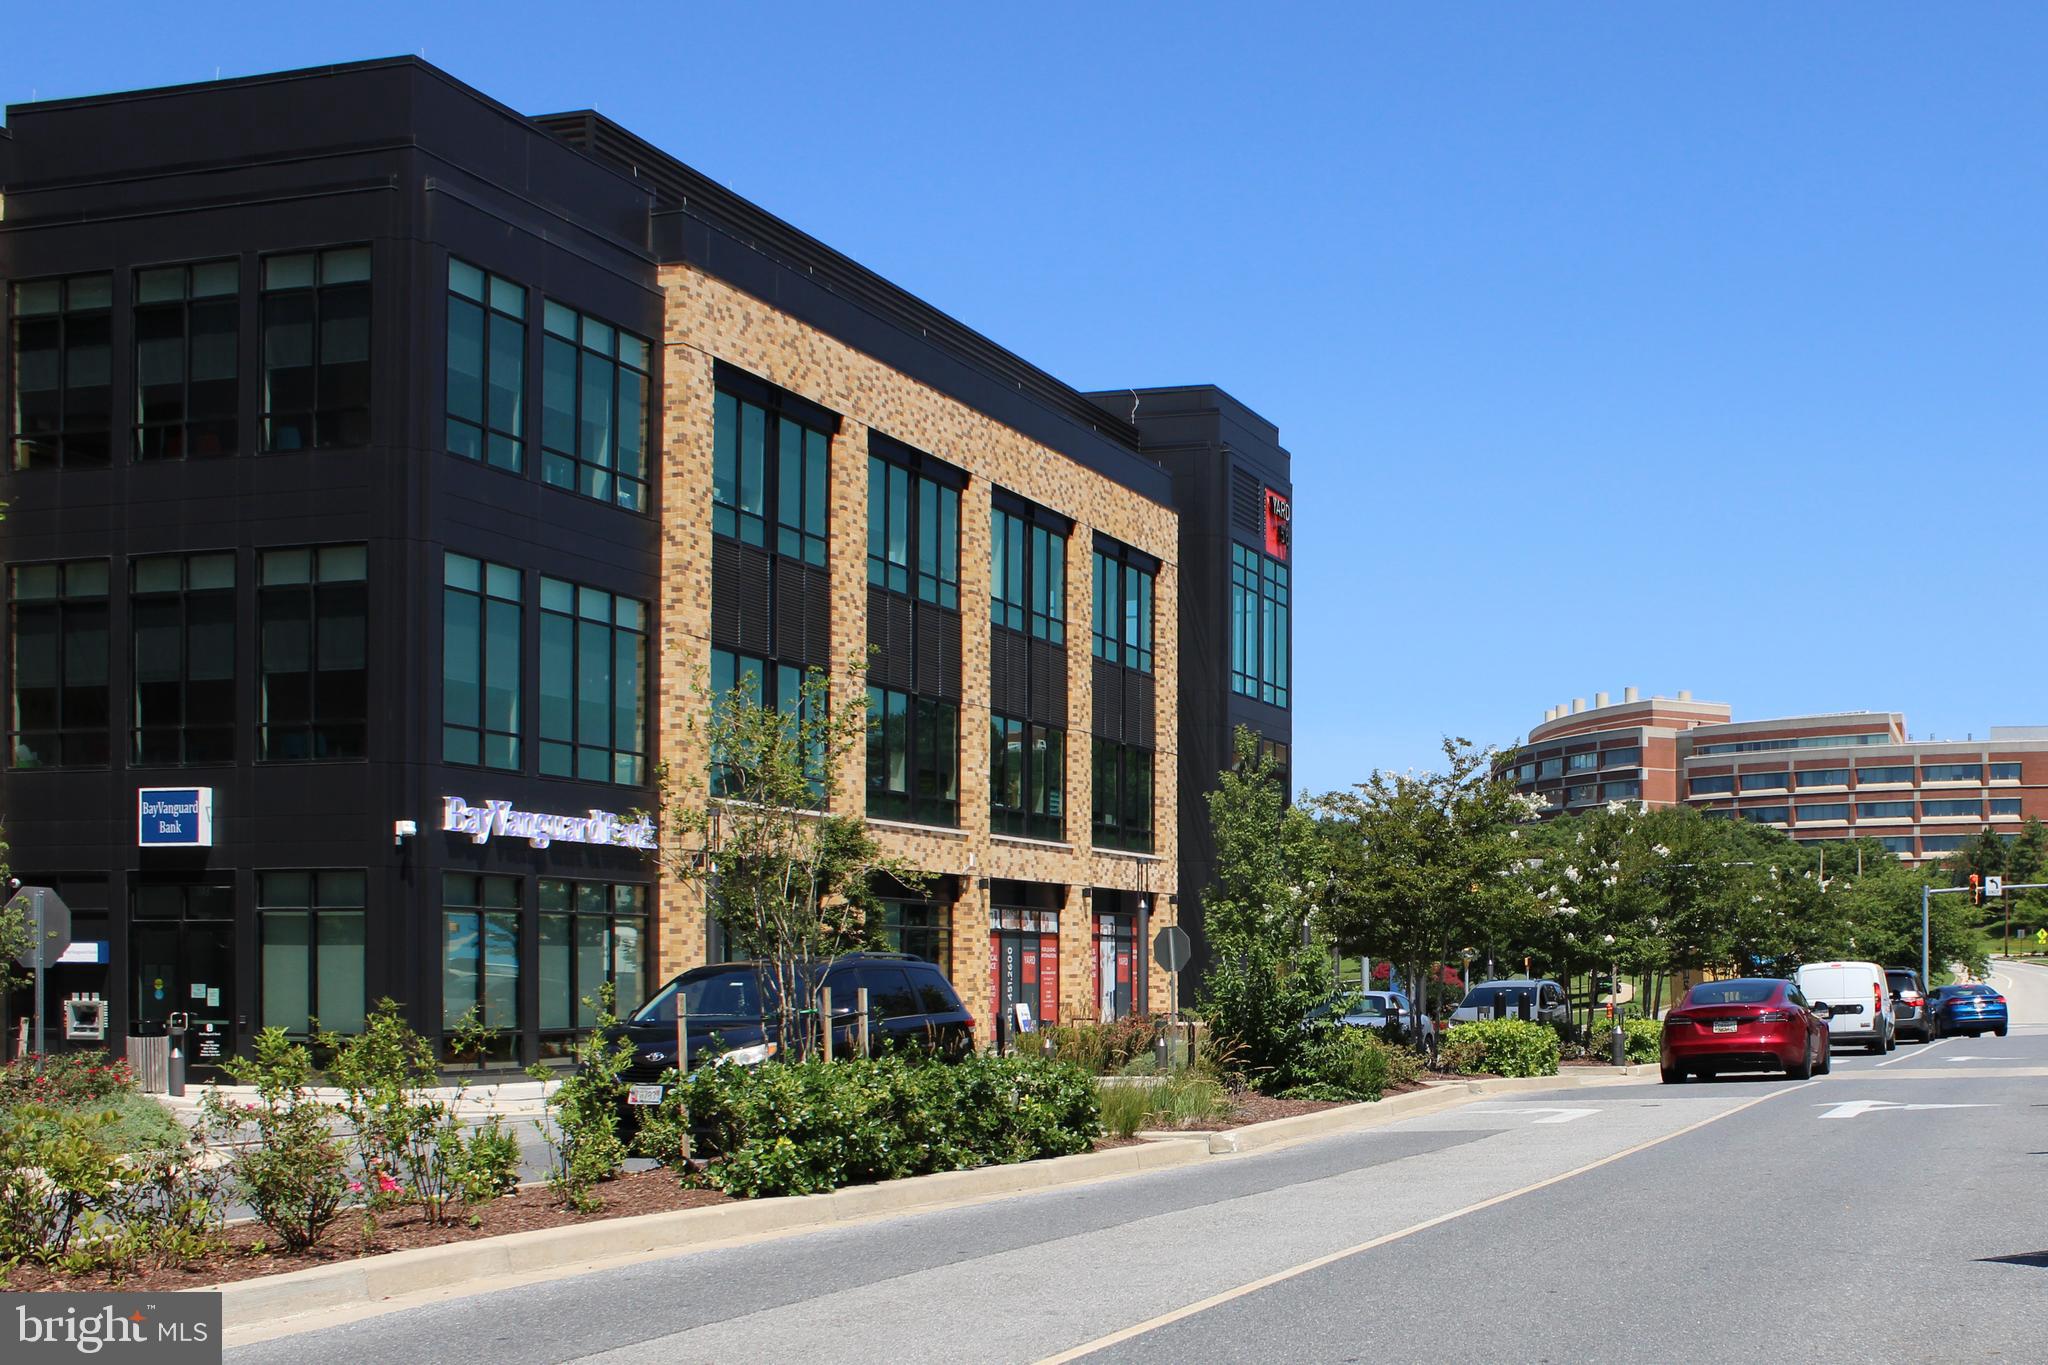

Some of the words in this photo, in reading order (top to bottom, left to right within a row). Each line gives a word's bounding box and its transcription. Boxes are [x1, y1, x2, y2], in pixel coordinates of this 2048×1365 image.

[1273, 496, 1290, 521] YARD
[142, 800, 199, 818] BayVanguard
[159, 820, 182, 833] Bank
[443, 796, 608, 849] BayVanguard
